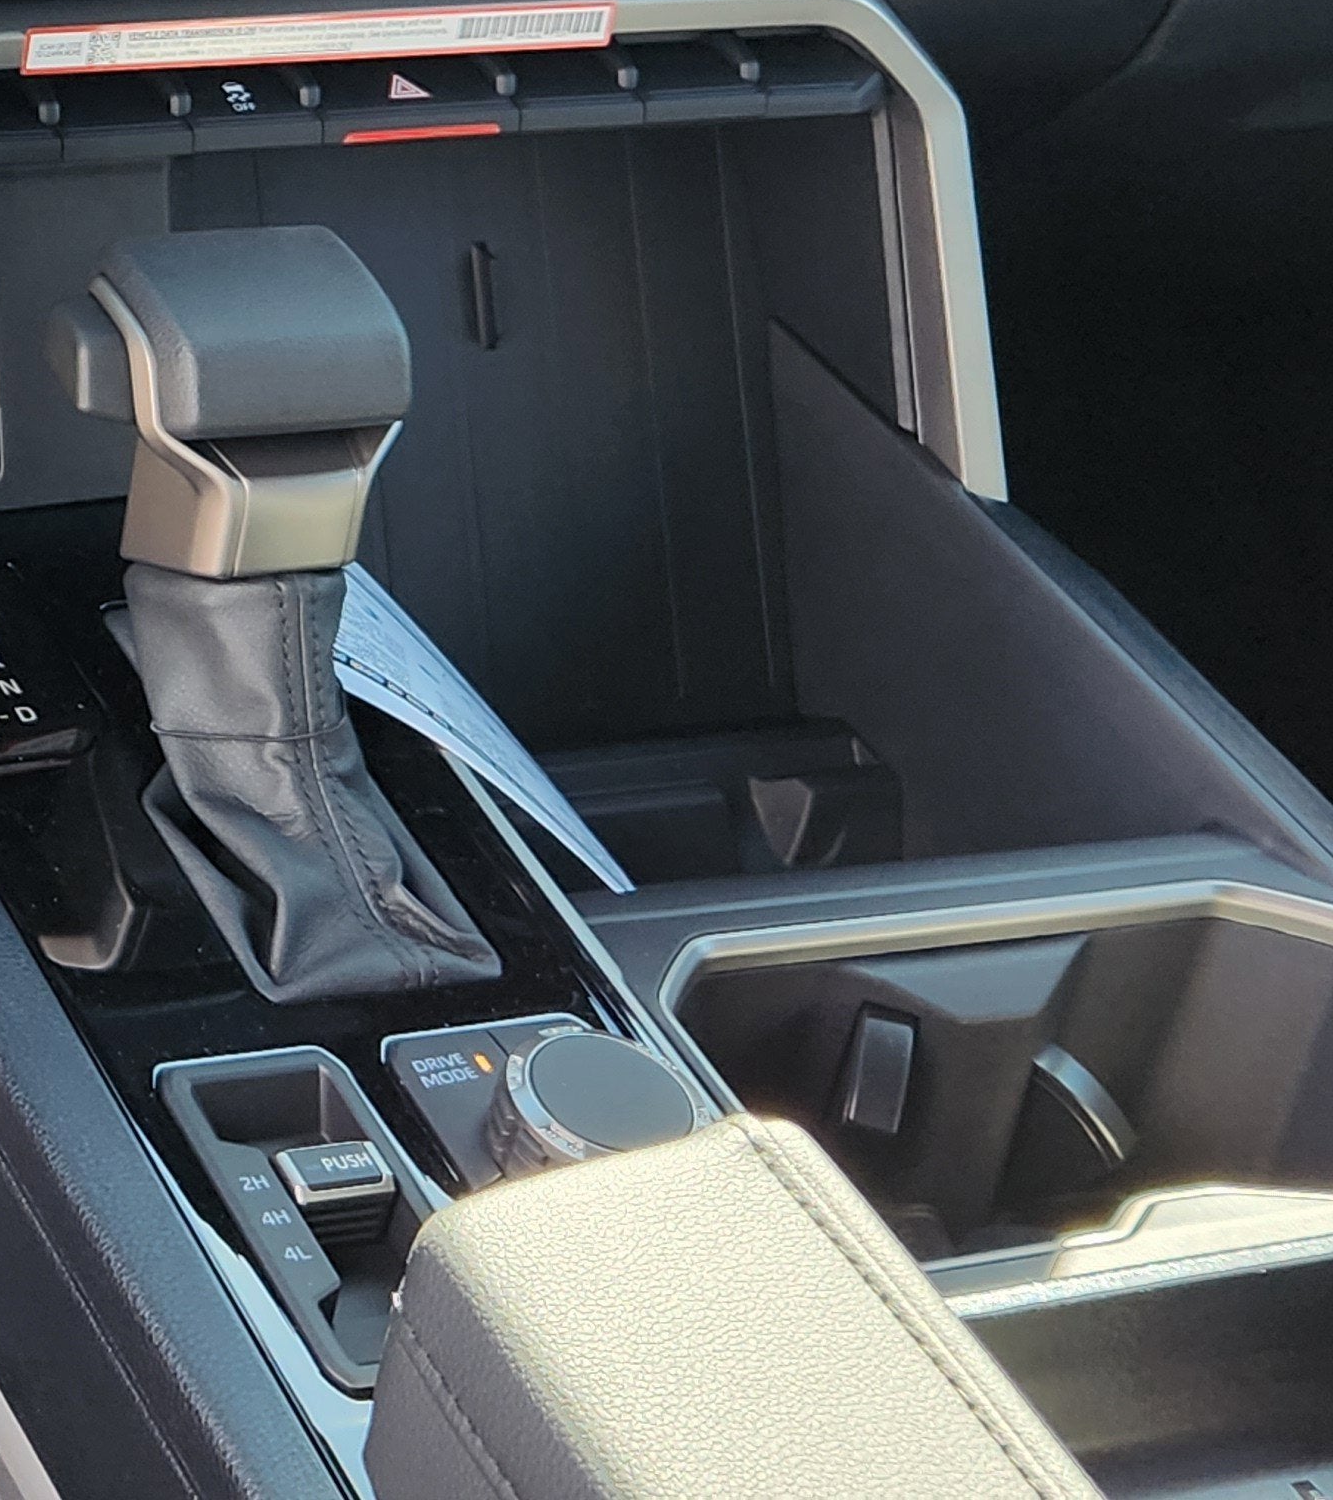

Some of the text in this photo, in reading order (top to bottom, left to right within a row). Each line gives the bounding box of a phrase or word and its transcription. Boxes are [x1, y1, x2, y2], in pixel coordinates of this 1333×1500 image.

[231, 102, 257, 112] OFF
[0, 678, 23, 695] N
[15, 706, 38, 723] D
[411, 1051, 466, 1076] DRIVE
[421, 1065, 479, 1088] MODE
[321, 1151, 375, 1172] PUSH
[239, 1174, 270, 1192] 2H
[261, 1209, 292, 1227] 4H
[283, 1244, 312, 1261] 4L
